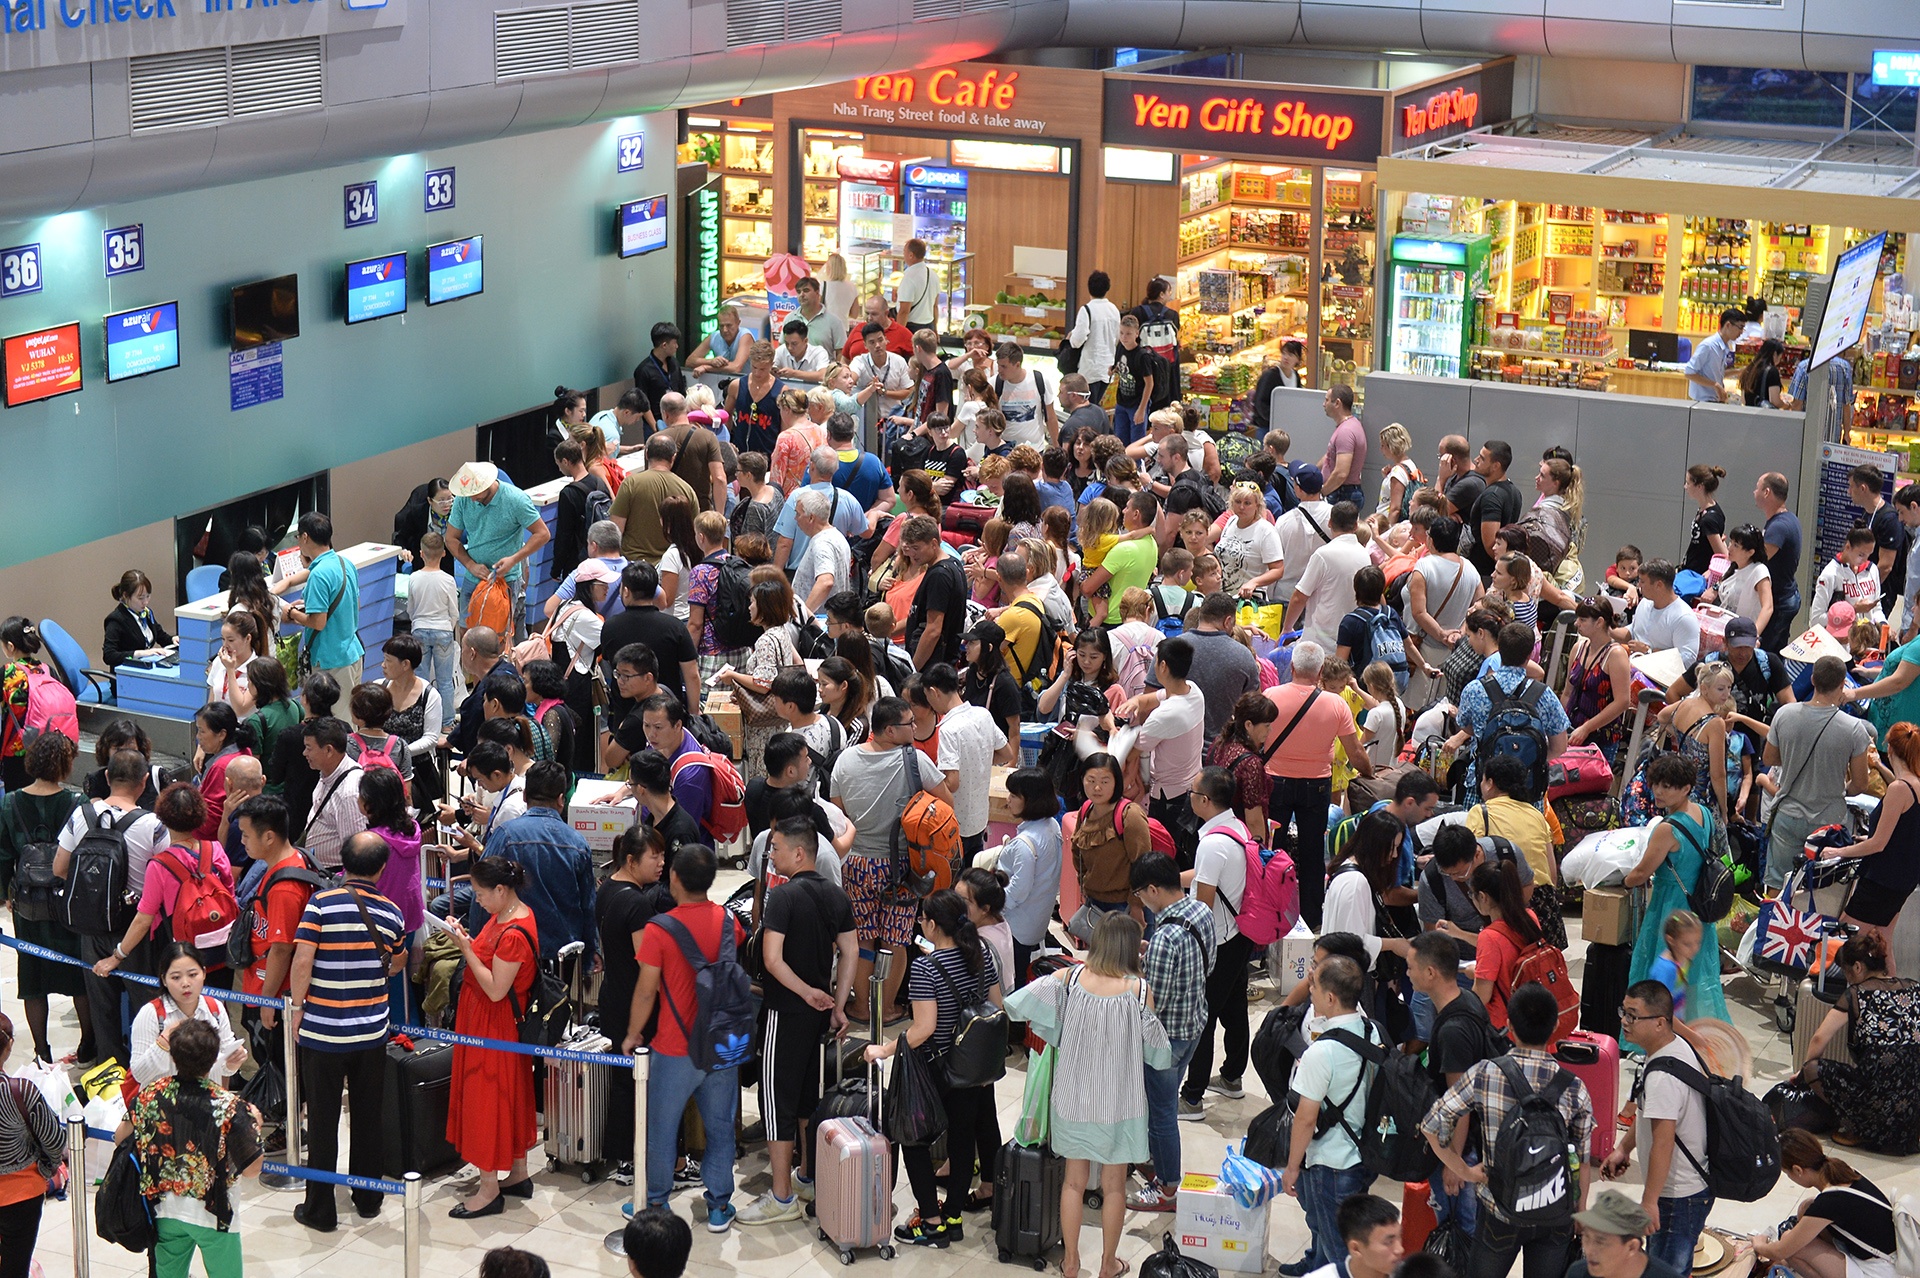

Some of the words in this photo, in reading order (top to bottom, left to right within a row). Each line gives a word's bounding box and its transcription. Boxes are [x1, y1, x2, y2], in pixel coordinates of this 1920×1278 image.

[853, 73, 915, 103] Yen
[927, 68, 1019, 110] Café
[833, 102, 857, 116] Nha
[862, 104, 895, 123] Trang
[898, 106, 934, 122] Street
[938, 109, 966, 124] food
[968, 112, 980, 125] &
[983, 112, 1011, 127] take
[1014, 118, 1046, 134] away
[1133, 94, 1189, 129] Yen
[1200, 97, 1264, 134] Gift
[1271, 101, 1353, 150] Shop
[1404, 104, 1426, 138] Yen
[1427, 91, 1452, 131] Gift
[1450, 86, 1478, 129] Shop
[621, 136, 642, 168] 32
[927, 170, 961, 184] pepsi
[428, 173, 452, 206] 33
[348, 188, 374, 222] 34
[627, 230, 648, 242] BUSINESS
[648, 227, 662, 238] CLASS
[108, 232, 140, 269] 35
[700, 189, 718, 316] RESTAURANT
[4, 251, 38, 290] 36
[122, 311, 151, 328] azurair
[21, 363, 30, 372] VJ
[30, 359, 46, 371] 5378
[58, 352, 74, 365] 18:35
[28, 346, 56, 360] WUHAN
[232, 353, 245, 363] ACV
[1789, 642, 1805, 657] nam
[1802, 630, 1822, 649] ex
[1295, 957, 1305, 980] ebis
[209, 988, 229, 999] RANH
[229, 993, 284, 1008] INTERNATIONAL
[439, 1032, 459, 1042] CAM
[460, 1036, 484, 1047] RANH
[534, 1047, 554, 1056] CAM
[556, 1049, 580, 1059] RANH
[582, 1053, 634, 1066] INTERNATIO
[262, 1162, 289, 1174] RANH
[346, 1177, 367, 1187] CAM
[369, 1181, 396, 1192] RANH
[1515, 1165, 1566, 1212] NIKE
[1184, 1237, 1195, 1245] 10
[1224, 1241, 1235, 1249] 11
